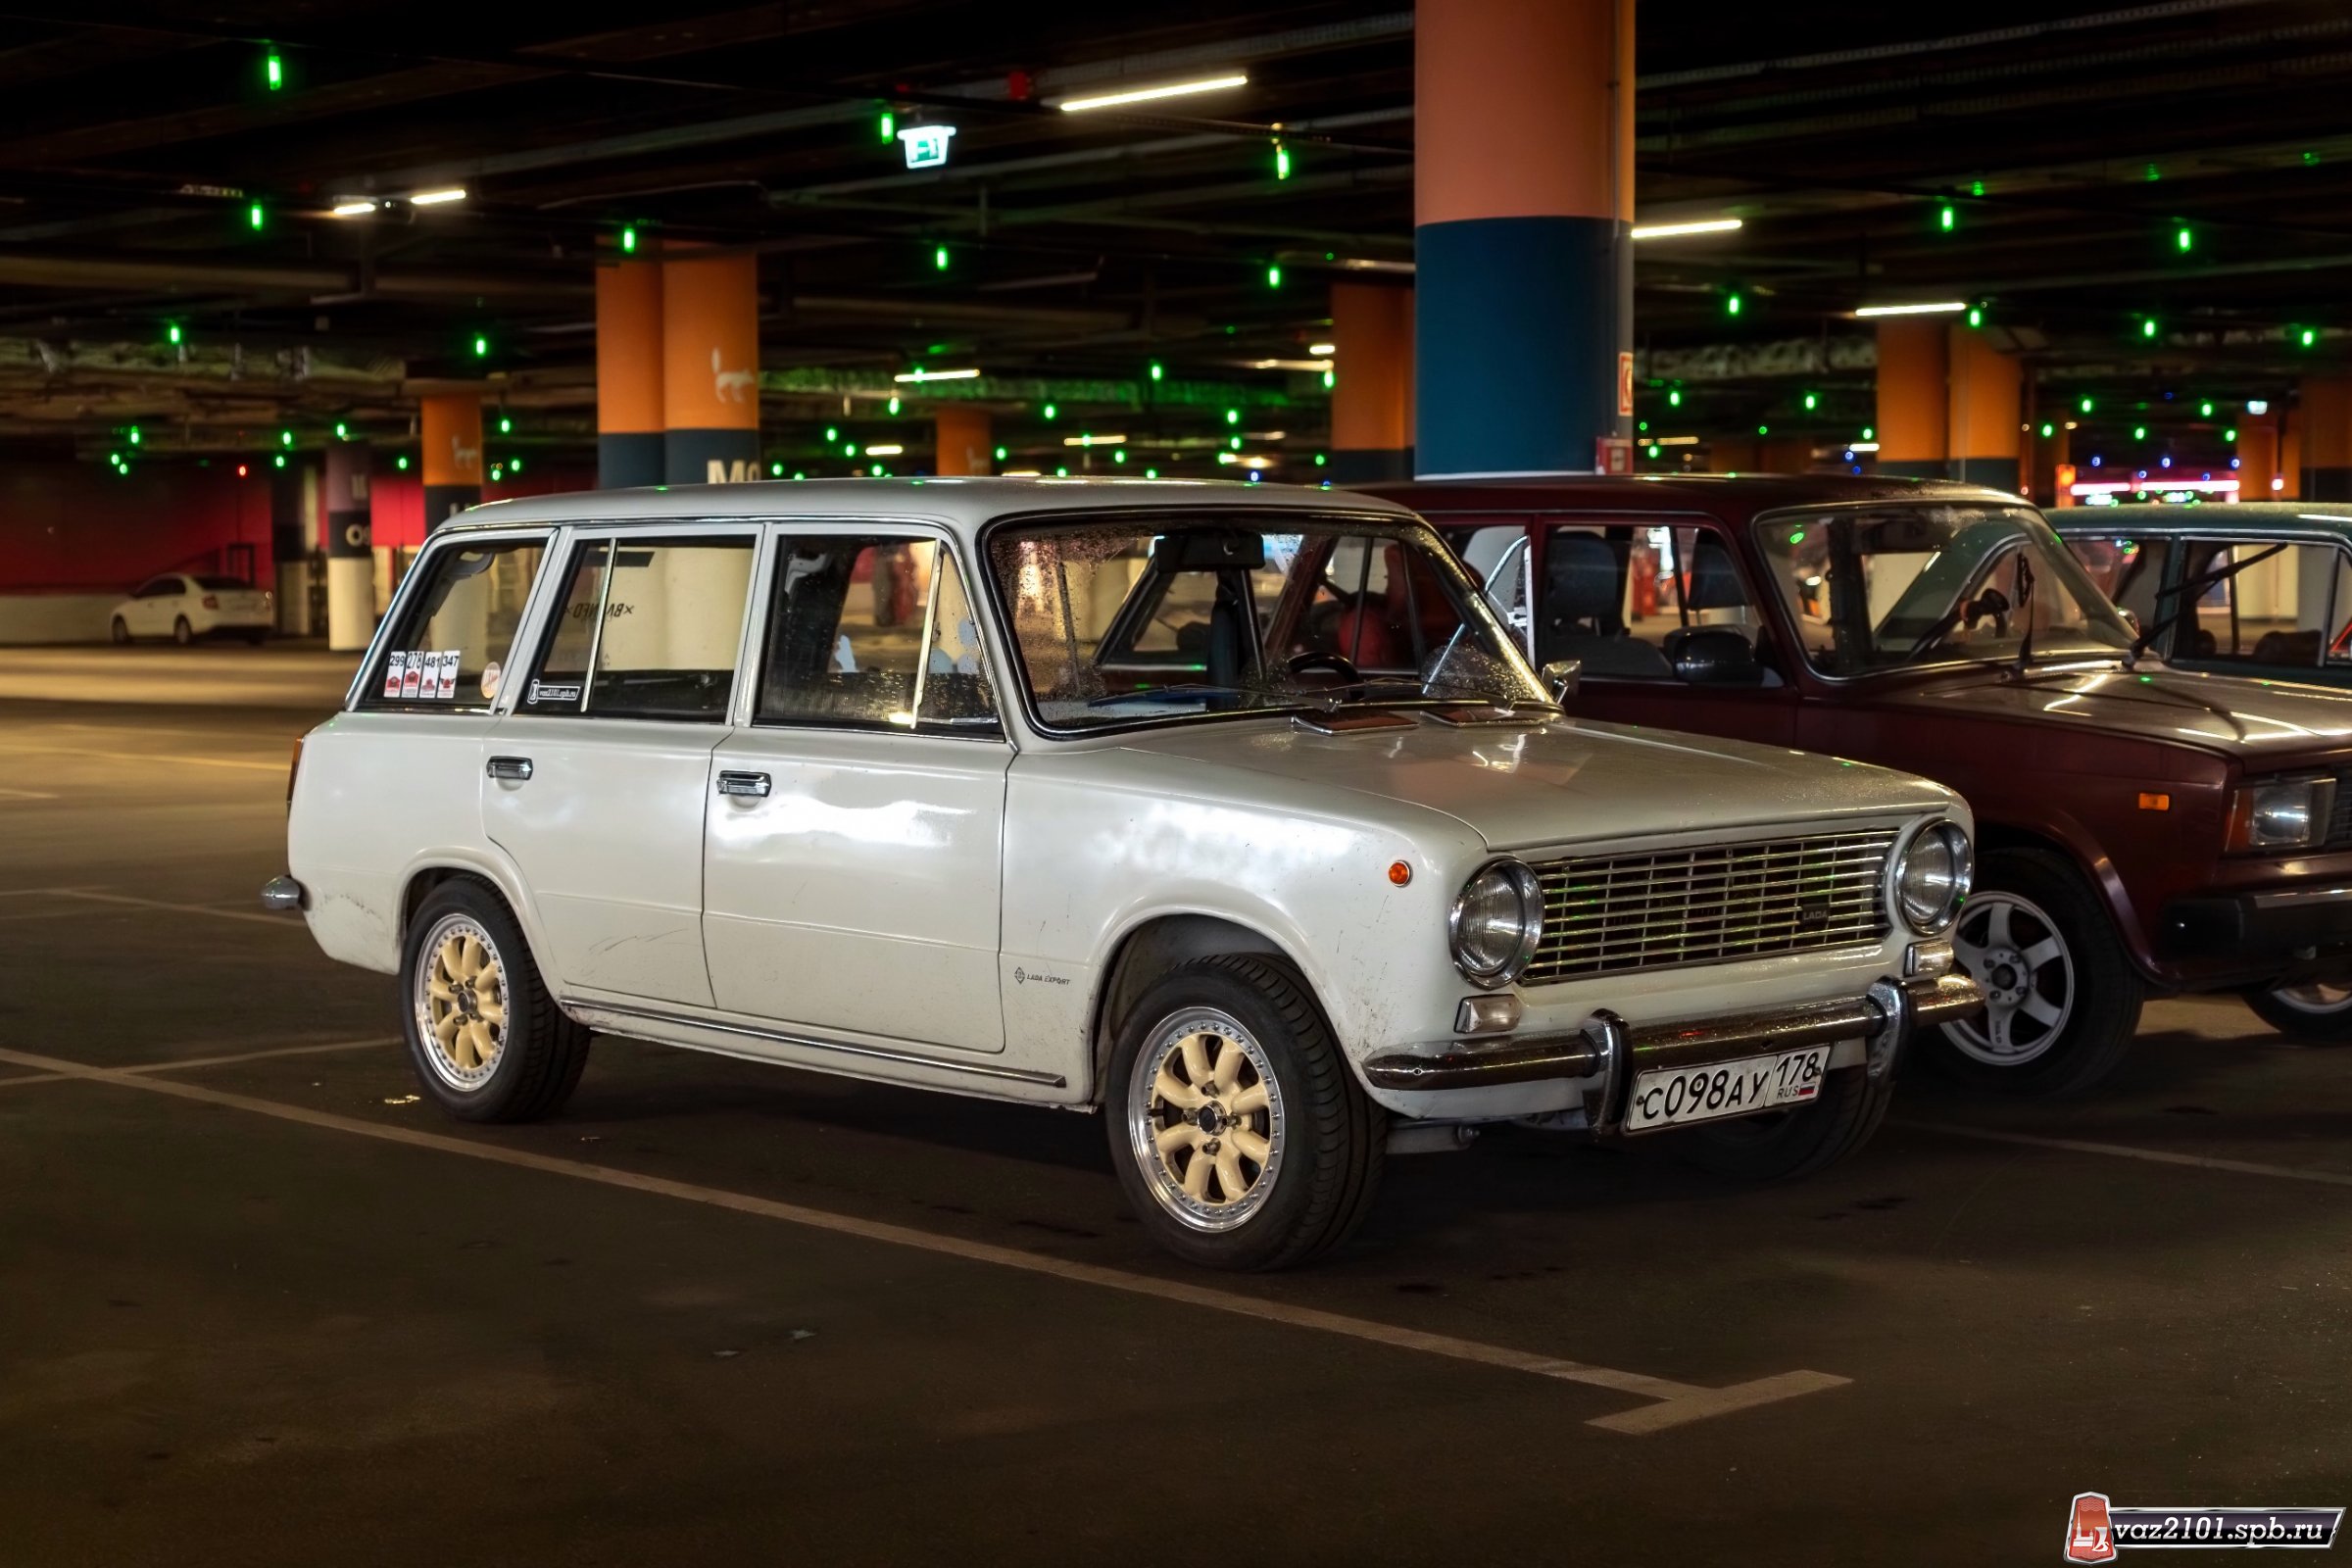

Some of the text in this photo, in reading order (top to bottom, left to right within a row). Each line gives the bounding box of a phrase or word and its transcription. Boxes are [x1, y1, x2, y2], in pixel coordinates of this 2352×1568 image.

[389, 656, 405, 666] 299
[407, 653, 422, 668] 278
[424, 657, 440, 667] 481
[442, 656, 459, 666] 347
[1803, 910, 1829, 920] LADA
[1045, 975, 1070, 985] EXPORT
[1776, 1053, 1819, 1087] 178
[1777, 1085, 1798, 1099] RUS
